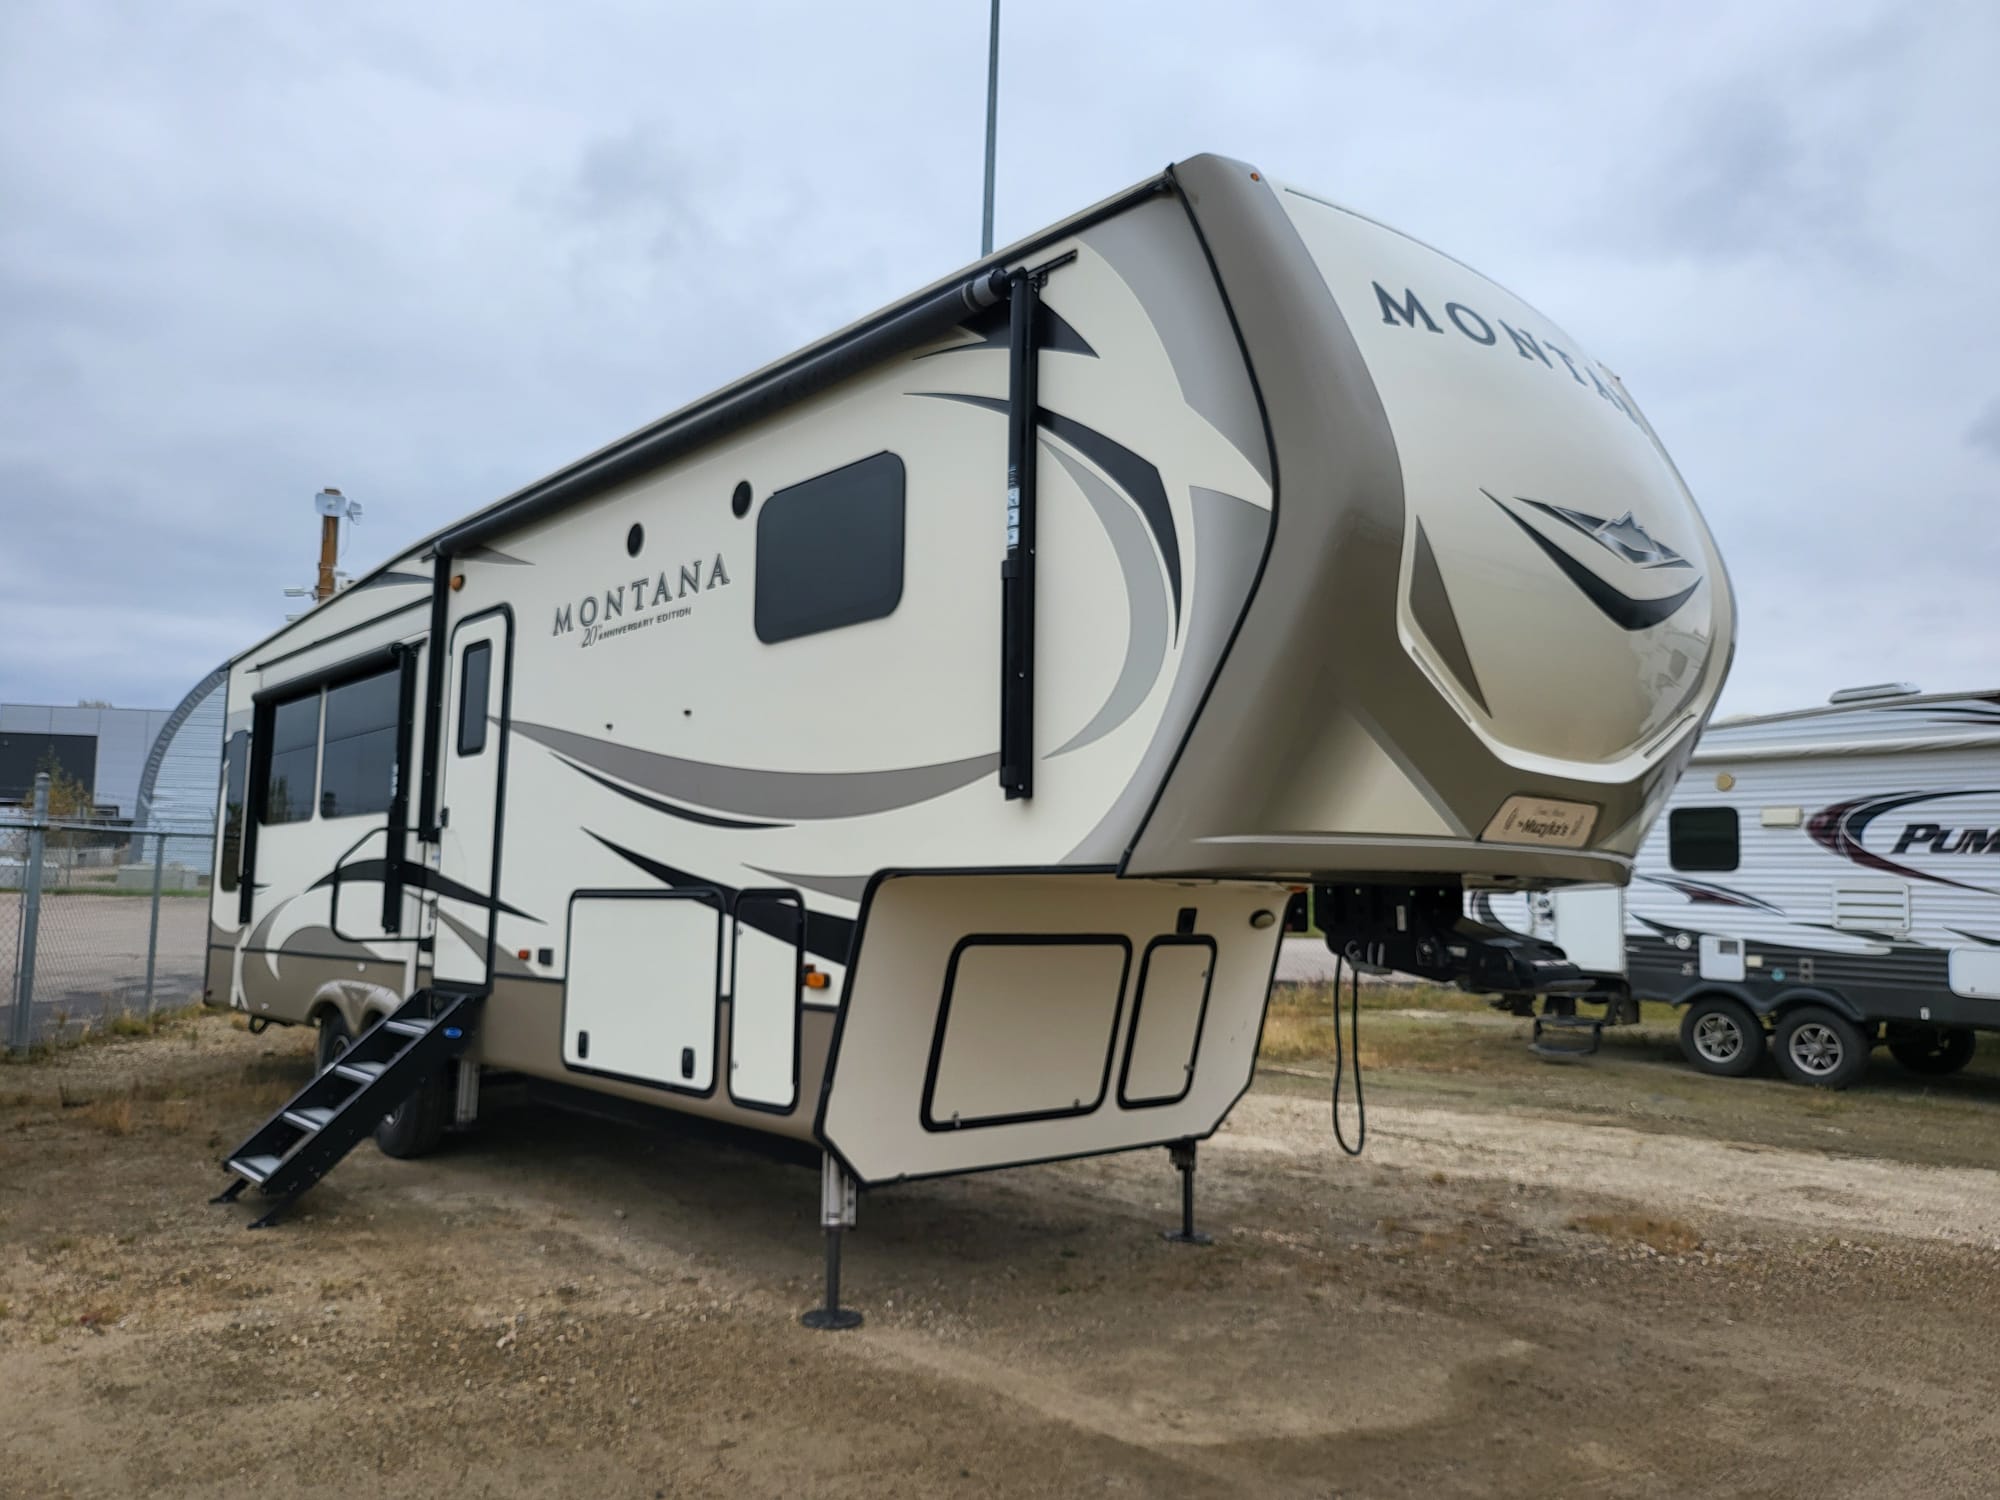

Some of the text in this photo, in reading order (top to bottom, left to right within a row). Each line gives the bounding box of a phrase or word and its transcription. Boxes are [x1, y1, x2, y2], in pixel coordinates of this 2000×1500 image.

[1371, 280, 1645, 432] MONTA
[553, 553, 730, 636] MONTANA
[598, 617, 654, 640] ANNIVERSARY
[657, 607, 693, 624] EDITION
